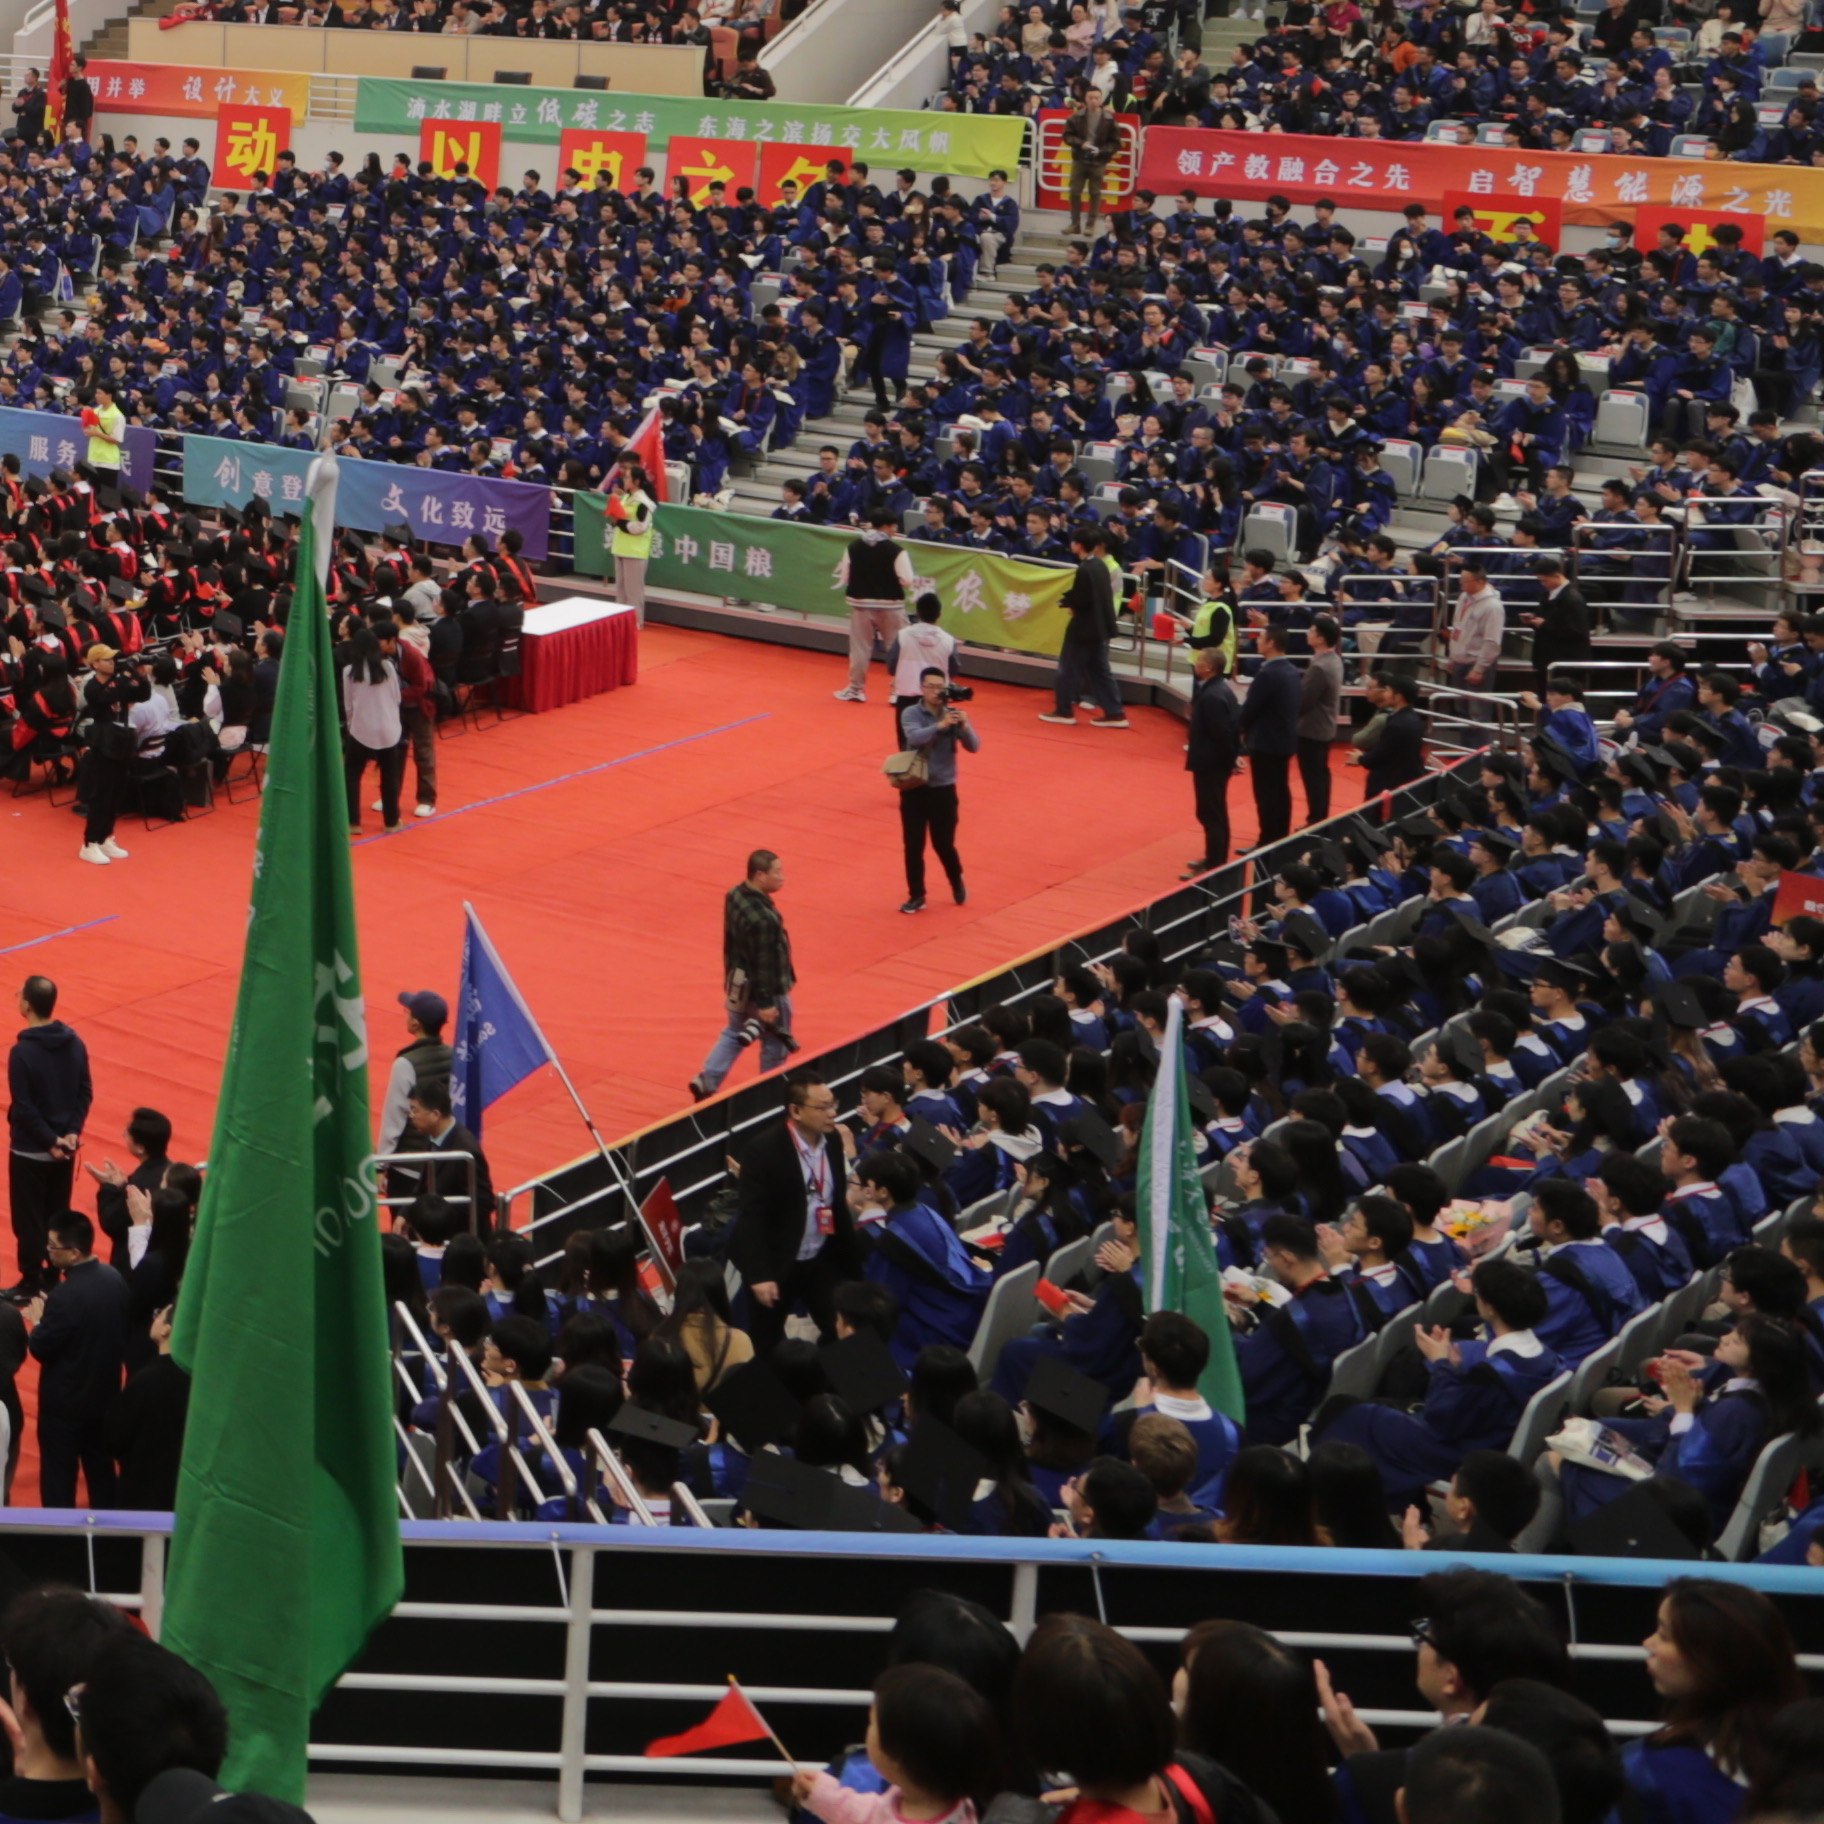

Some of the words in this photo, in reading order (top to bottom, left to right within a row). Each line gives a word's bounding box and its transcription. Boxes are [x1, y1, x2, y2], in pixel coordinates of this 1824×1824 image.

[182, 75, 286, 108] 设计大义
[225, 118, 279, 178] 动
[406, 94, 656, 133] 滴水湖畔立低碳之志
[698, 114, 952, 156] 东海之滨扬交大风帆
[1176, 149, 1412, 192] 领产教融合之先
[1467, 162, 1795, 218] 启智慧能源之光
[29, 434, 132, 477] 服务民
[214, 455, 304, 503] 创意登
[380, 482, 508, 537] 文化致远
